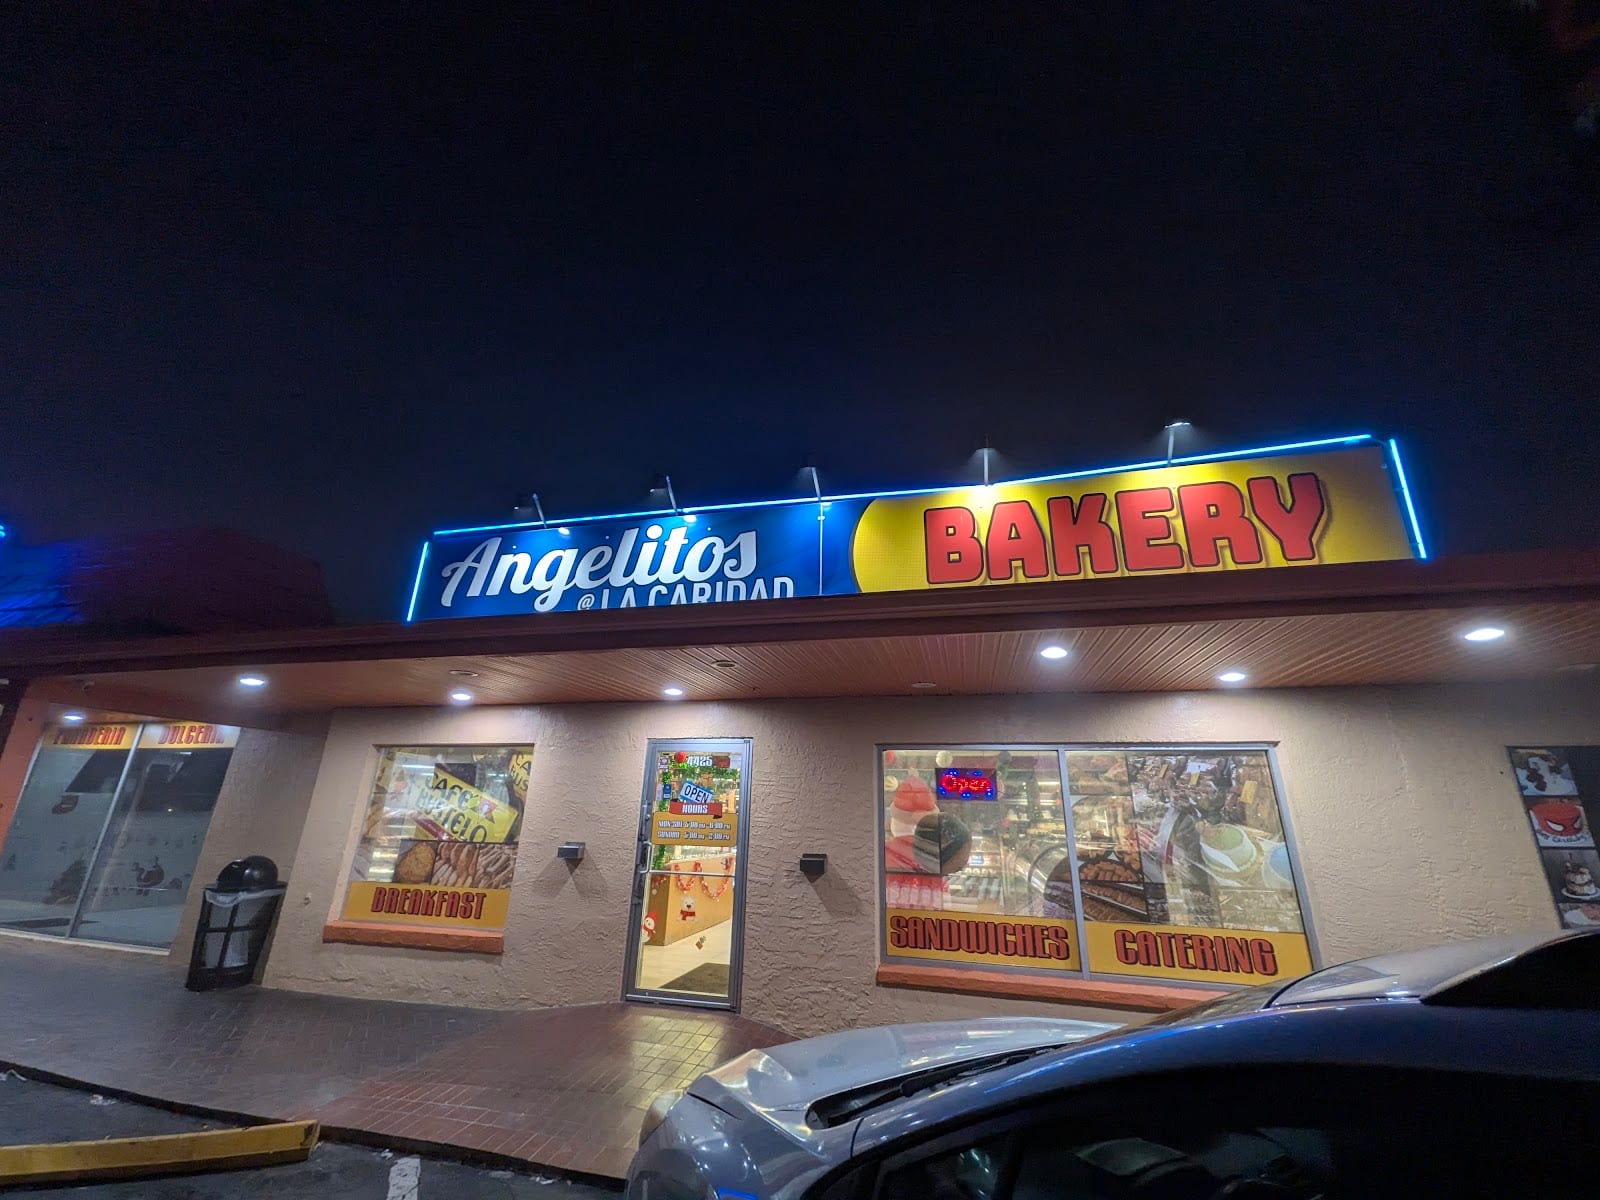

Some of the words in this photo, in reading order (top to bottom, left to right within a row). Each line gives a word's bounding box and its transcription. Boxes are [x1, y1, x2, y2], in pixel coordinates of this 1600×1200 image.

[925, 472, 1326, 587] BAKERY
[441, 525, 757, 612] Angelitos
[687, 755, 713, 767] 4425
[682, 804, 708, 814] HOURS
[684, 784, 710, 804] OPEN
[371, 886, 487, 920] BREAKFAST
[890, 915, 1070, 961] SANDWICHES
[1115, 929, 1279, 977] CATERING
